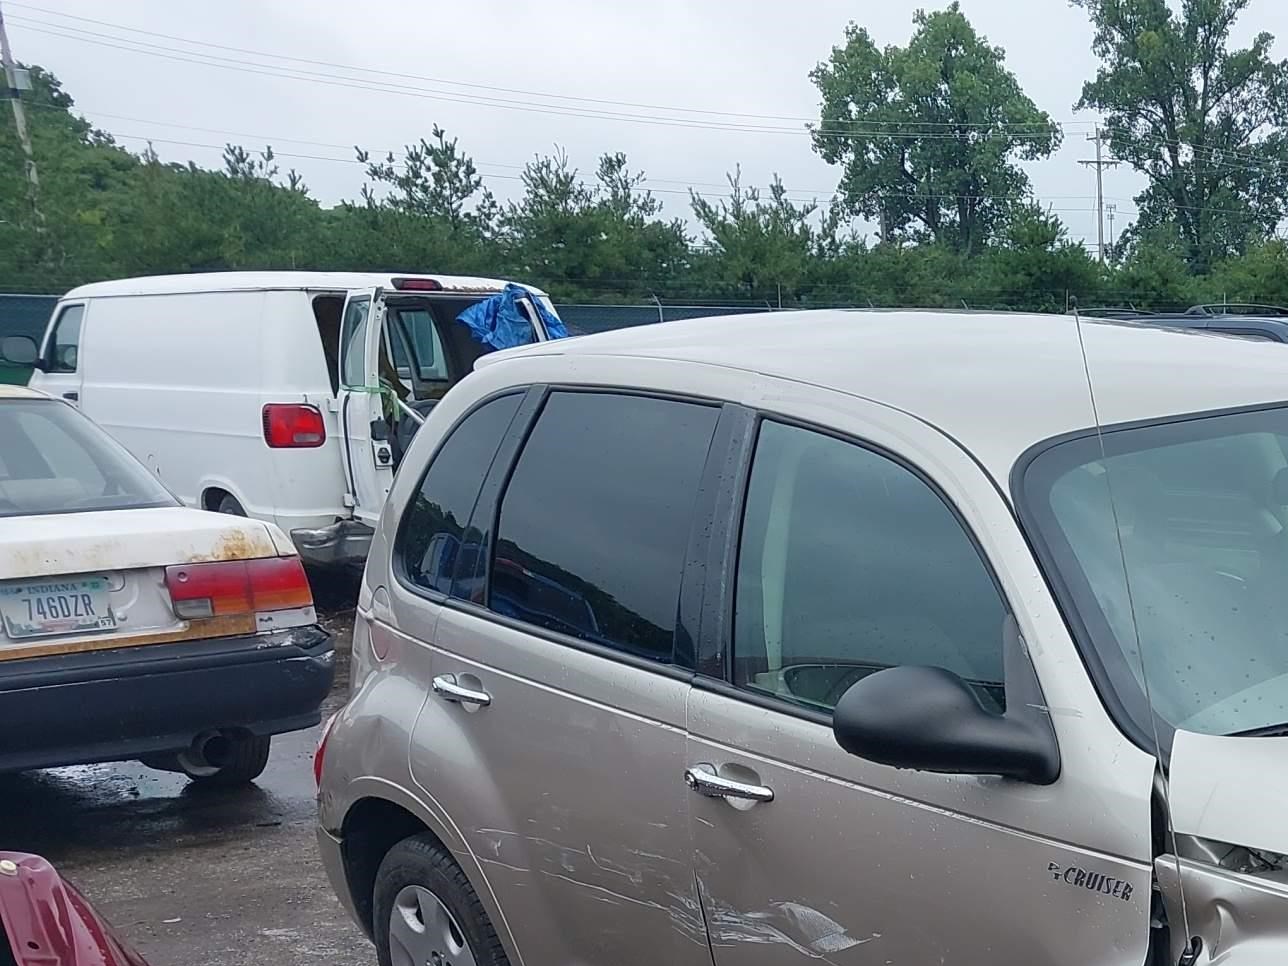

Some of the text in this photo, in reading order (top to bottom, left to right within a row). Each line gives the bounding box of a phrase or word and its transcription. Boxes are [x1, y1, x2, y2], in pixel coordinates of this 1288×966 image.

[26, 583, 77, 595] INDIANA
[21, 593, 95, 621] 746DZR
[1063, 866, 1134, 902] CRUISER
